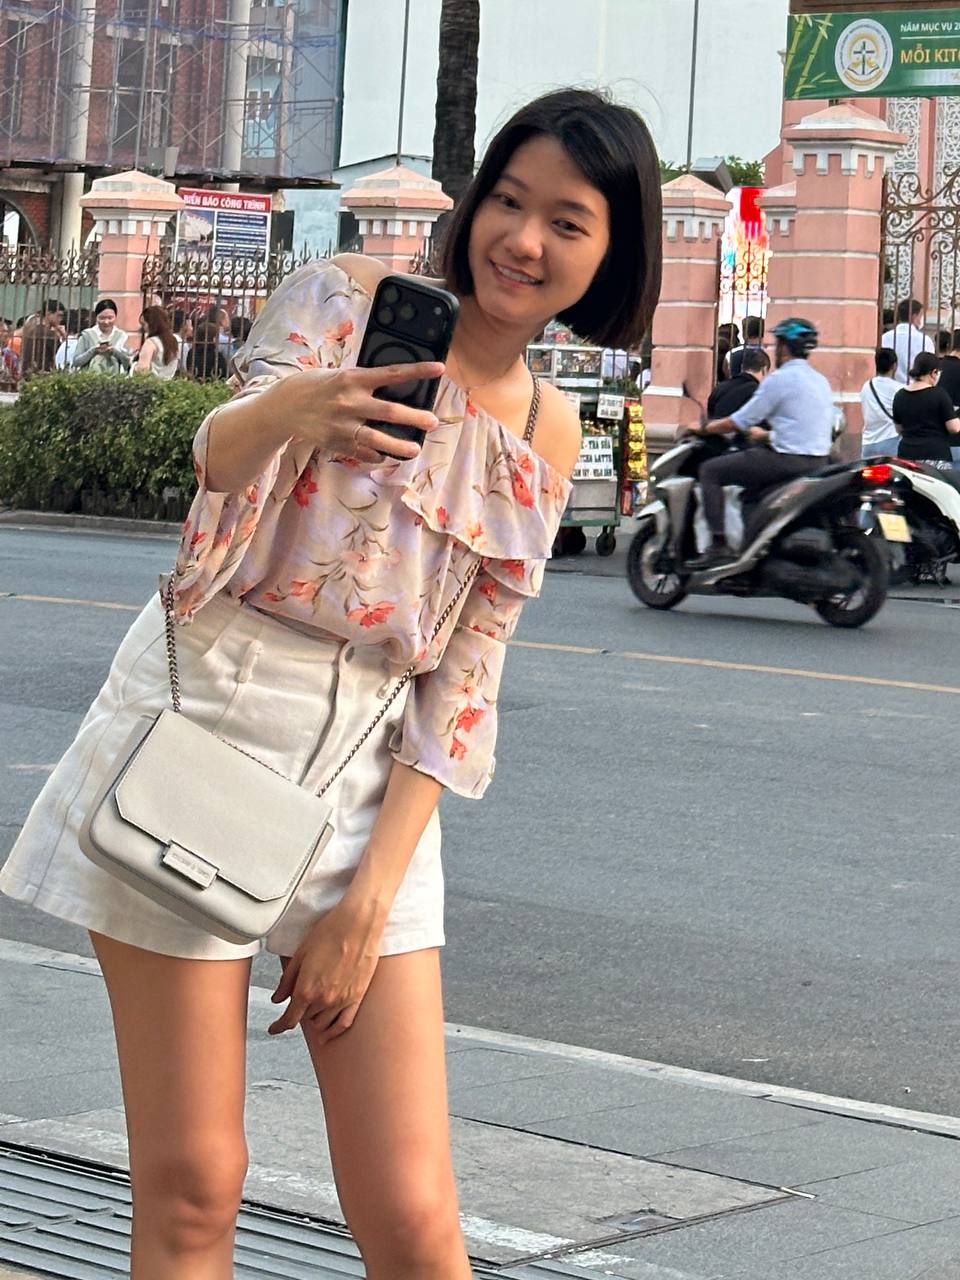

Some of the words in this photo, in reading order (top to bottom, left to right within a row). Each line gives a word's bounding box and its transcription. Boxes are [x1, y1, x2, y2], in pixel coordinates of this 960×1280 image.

[900, 22, 920, 33] NĂM
[921, 22, 940, 34] MỤC
[900, 43, 930, 64] MỖI
[202, 195, 219, 207] BÁO
[220, 197, 242, 209] CÔNG
